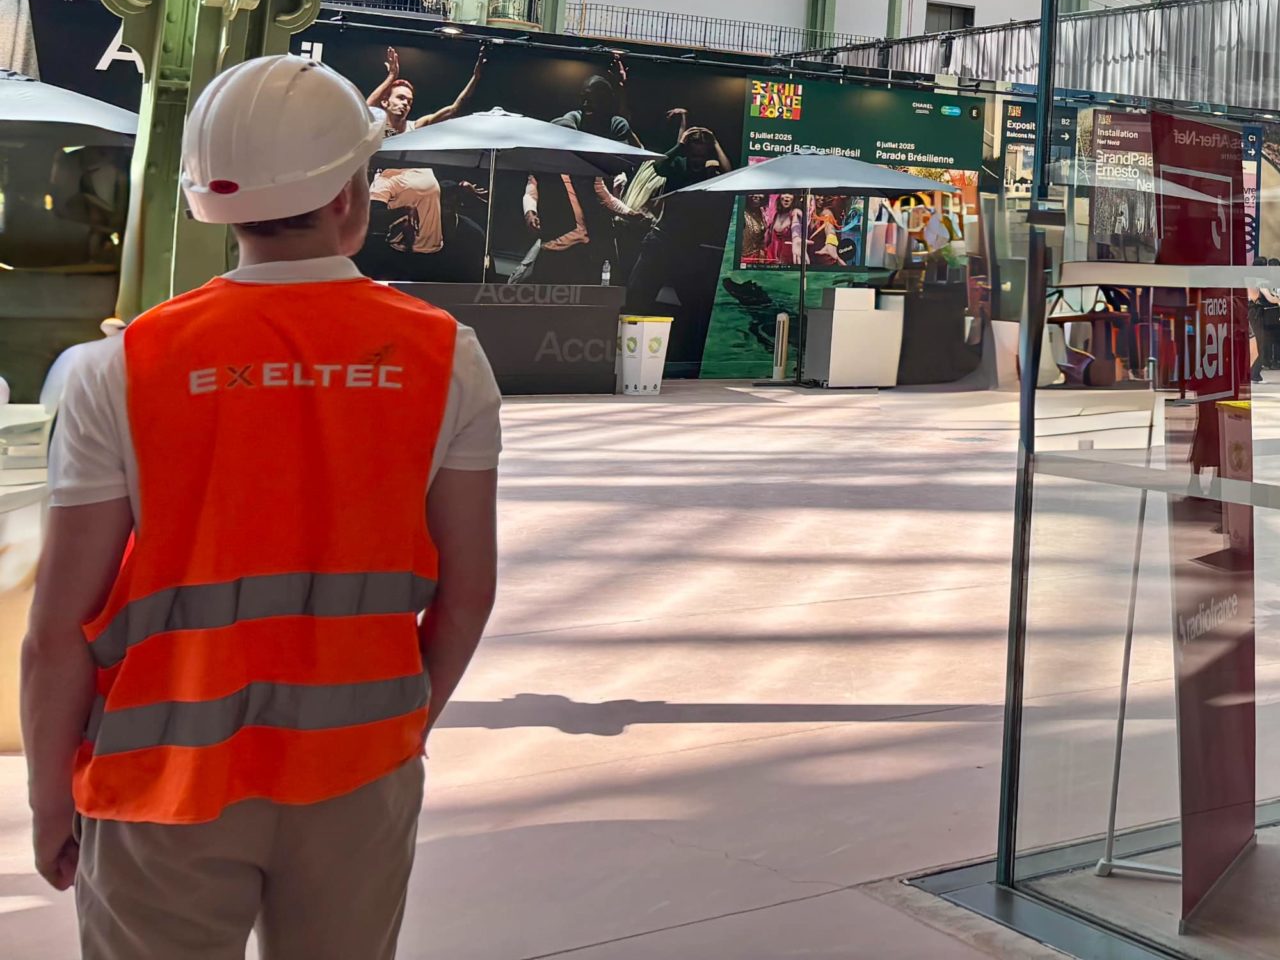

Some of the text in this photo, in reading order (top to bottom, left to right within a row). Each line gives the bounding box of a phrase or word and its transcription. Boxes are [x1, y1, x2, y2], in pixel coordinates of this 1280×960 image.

[1007, 120, 1036, 131] Exposit
[1061, 118, 1071, 126] B2
[755, 132, 774, 140] juillet
[775, 133, 793, 141] 2025
[1006, 131, 1027, 139] Balcons
[1097, 128, 1139, 139] Installation
[749, 141, 761, 151] Le
[762, 142, 792, 153] Grand
[881, 141, 898, 149] juillet
[876, 150, 955, 164] Parade Brésilienne
[1096, 150, 1153, 166] GrandPala
[1095, 162, 1140, 178] Ernesto
[1136, 178, 1155, 192] Ne
[1243, 186, 1257, 194] vre
[474, 284, 582, 304] Accueil
[1201, 298, 1227, 316] rance
[535, 330, 617, 363] Accu
[188, 362, 404, 395] EXELTEC
[1186, 593, 1238, 642] radiofrance
